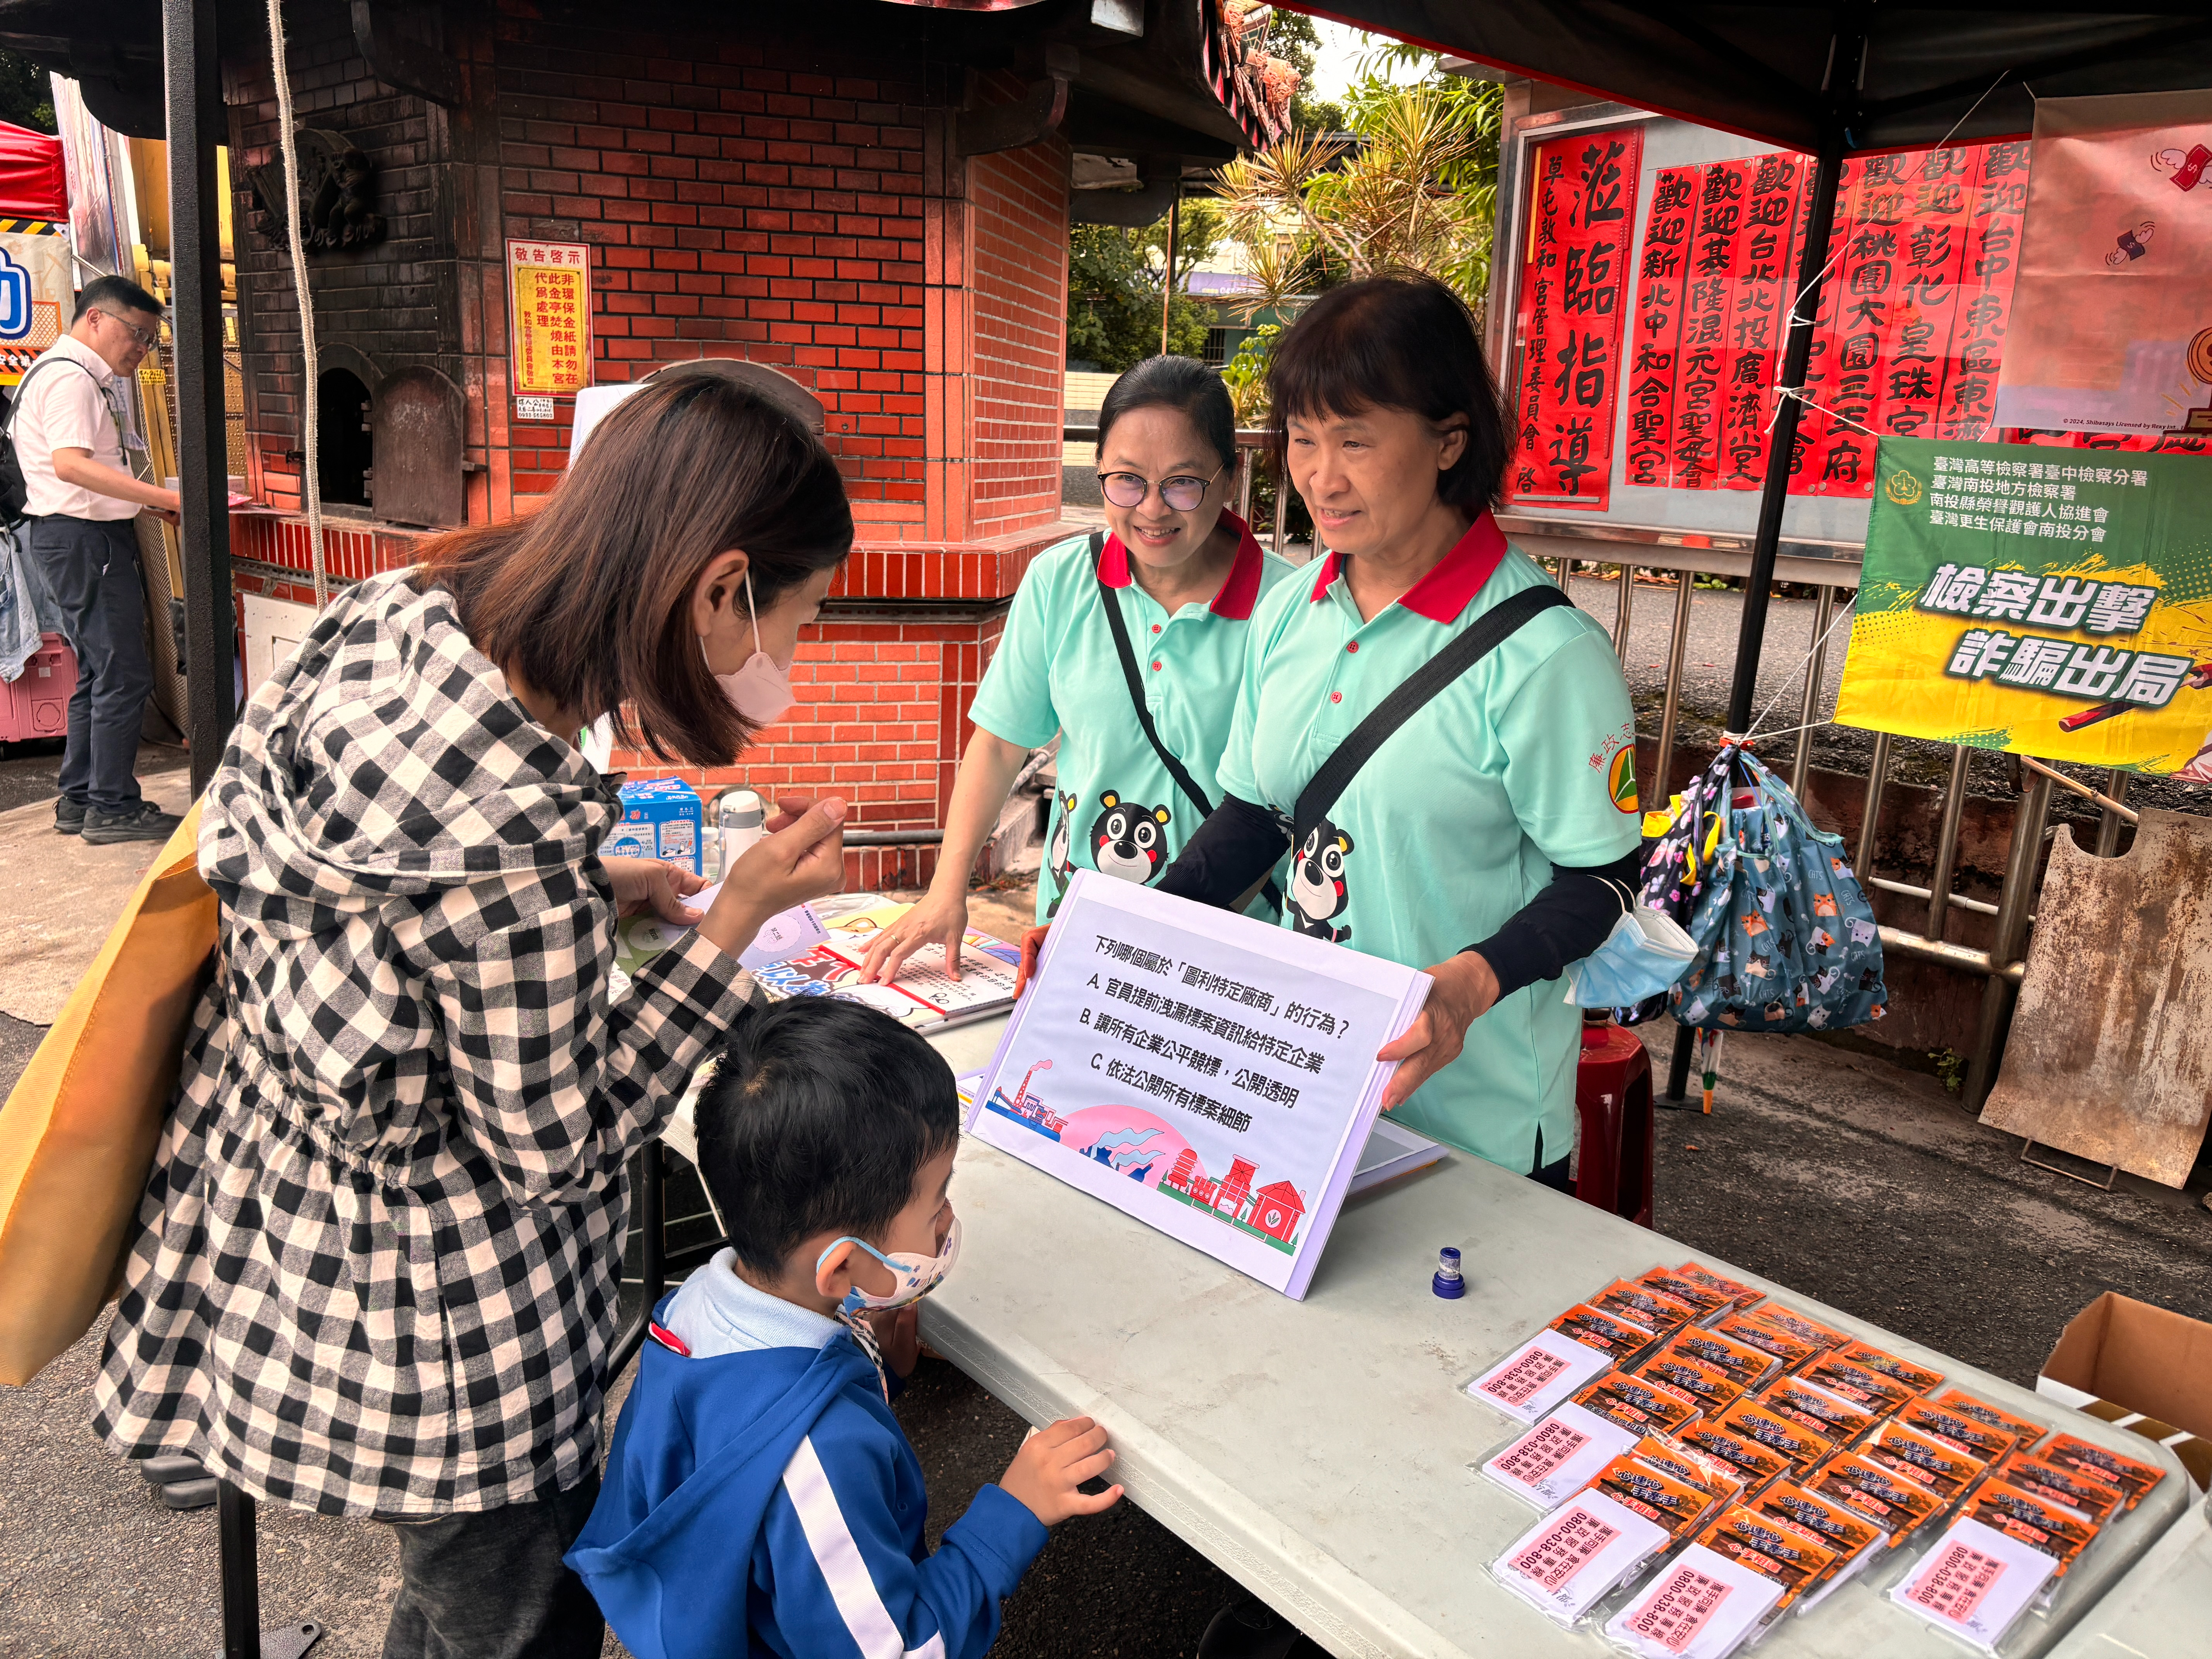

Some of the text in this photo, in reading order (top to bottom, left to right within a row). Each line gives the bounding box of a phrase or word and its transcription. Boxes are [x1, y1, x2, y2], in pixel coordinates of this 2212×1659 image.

[548, 273, 565, 385] 此金亭焚燒由本宮
[562, 273, 578, 385] 非環保金紙請勿在
[1628, 172, 1692, 485] 歡迎新北中和合聖宮
[1674, 163, 1742, 488] 歡迎基隆混元宮聖母會
[1719, 155, 1795, 483] 歡迎台北北投廣濟堂
[1930, 475, 2076, 501] 臺灣南投地方檢察署
[1933, 456, 2148, 487] 臺灣高等檢察署臺中檢察分署
[1929, 493, 2110, 524] 南投縣榮譽觀護人協進會
[1929, 510, 2107, 543] 臺灣更生保護會南投分會
[1920, 563, 2158, 634] 檢察出擊
[1948, 629, 2193, 706] 詐騙出局
[1079, 1008, 1091, 1025] B.
[1086, 973, 1326, 1074] A. 官員提前洩漏標案資訊給特定企業
[1106, 1057, 1253, 1133] 依法公開所有標案細節
[1488, 1351, 1543, 1392] 0800-038-800
[1614, 1382, 1654, 1398] 心連心
[1508, 1382, 1537, 1403] 食在安心
[1606, 1398, 1649, 1422] 心手相連
[1625, 1394, 1666, 1411] 手牽手
[1742, 1413, 1785, 1432] 心連心
[1755, 1429, 1799, 1449] 手牽手
[1501, 1423, 1559, 1470] 0800-038-800
[1510, 1427, 1571, 1476] 廉政服務專線
[1523, 1459, 1554, 1482] 食在安心
[1611, 1492, 1661, 1520] 心手相連
[1632, 1486, 1677, 1505] 手牽手
[1520, 1513, 1587, 1569] 0800-038-800
[1530, 1518, 1600, 1577] 廉政服務專線
[1544, 1554, 1580, 1585] 食在安心
[1918, 1547, 1968, 1603] 0800-038-800
[1637, 1571, 1695, 1632] 0800-038-800
[1650, 1575, 1709, 1639] 廉政服務專線
[1666, 1614, 1698, 1646] 食在安心
